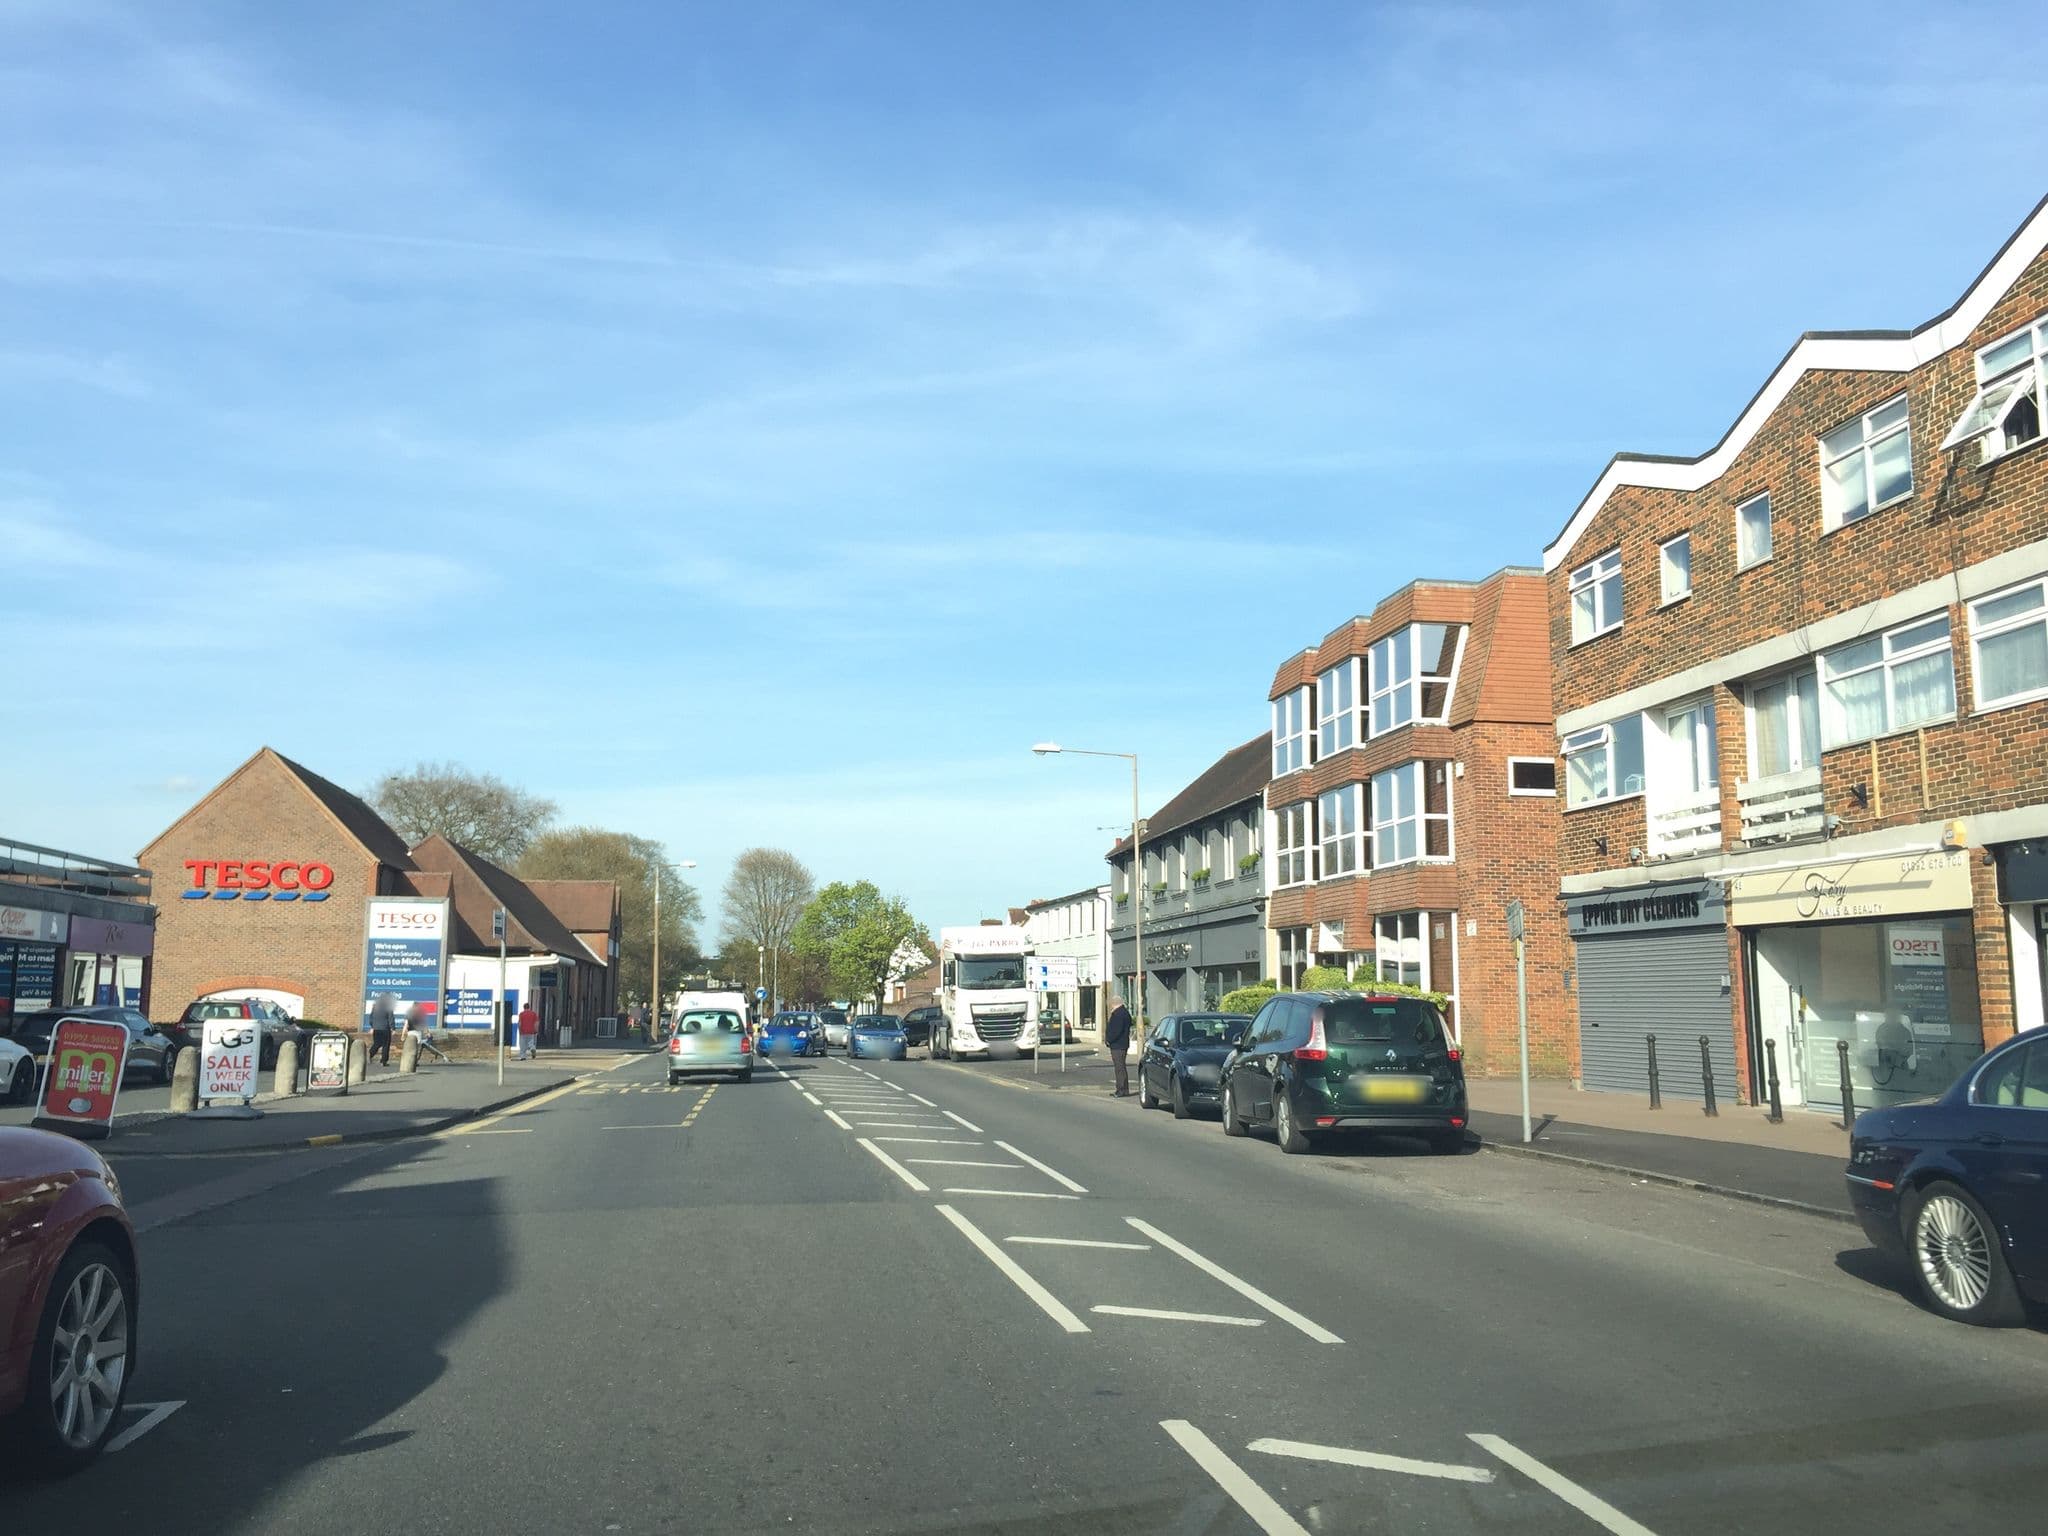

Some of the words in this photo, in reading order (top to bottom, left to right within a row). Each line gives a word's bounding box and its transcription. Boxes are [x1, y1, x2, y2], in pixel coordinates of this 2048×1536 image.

[184, 859, 335, 891] TESCO
[1582, 901, 1618, 928] EPPING
[1620, 897, 1642, 925] DRY
[1643, 890, 1700, 923] CLEANERS
[1818, 906, 1840, 917] NAILS
[1853, 902, 1883, 915] BEAUTY
[376, 912, 437, 924] TESCO
[373, 957, 391, 966] 6am
[392, 958, 400, 966] to
[401, 957, 437, 967] Midnight
[392, 978, 411, 986] Collect
[209, 1028, 254, 1049] UGG
[207, 1055, 252, 1070] SALE
[58, 1064, 111, 1084] millers
[215, 1071, 250, 1081] WEEK
[210, 1082, 244, 1093] ONLY
